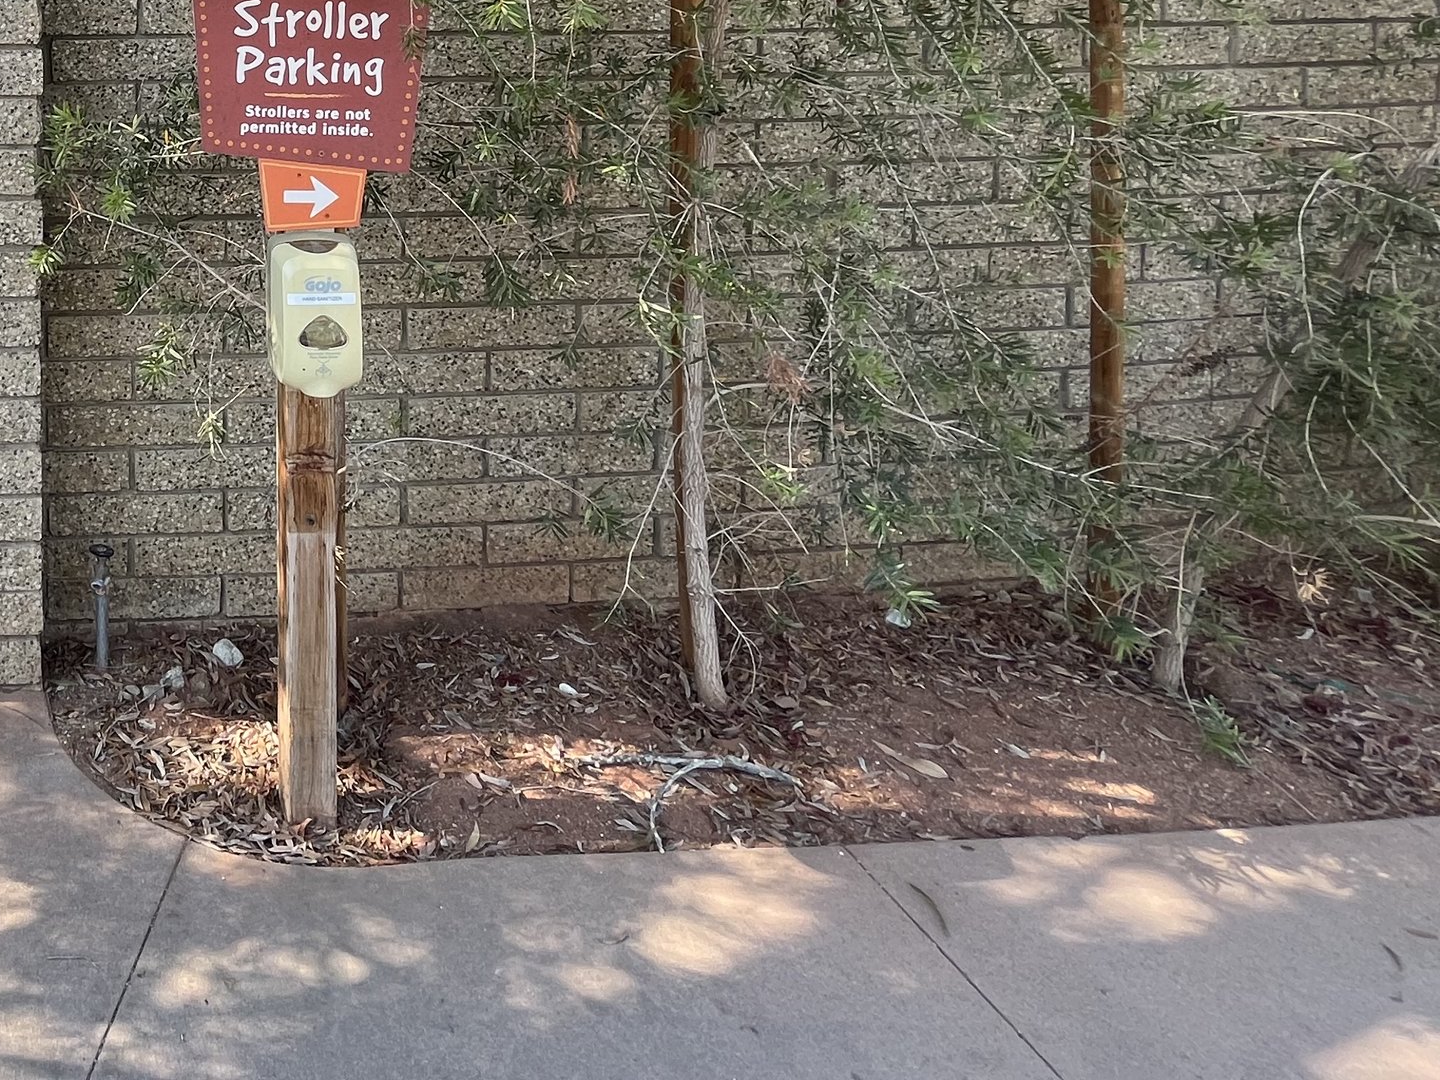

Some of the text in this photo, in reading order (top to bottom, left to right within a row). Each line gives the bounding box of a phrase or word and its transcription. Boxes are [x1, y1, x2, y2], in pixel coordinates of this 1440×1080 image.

[236, 45, 385, 96] Parking
[245, 104, 371, 121] Strollers are not
[240, 121, 374, 137] permitted inside.
